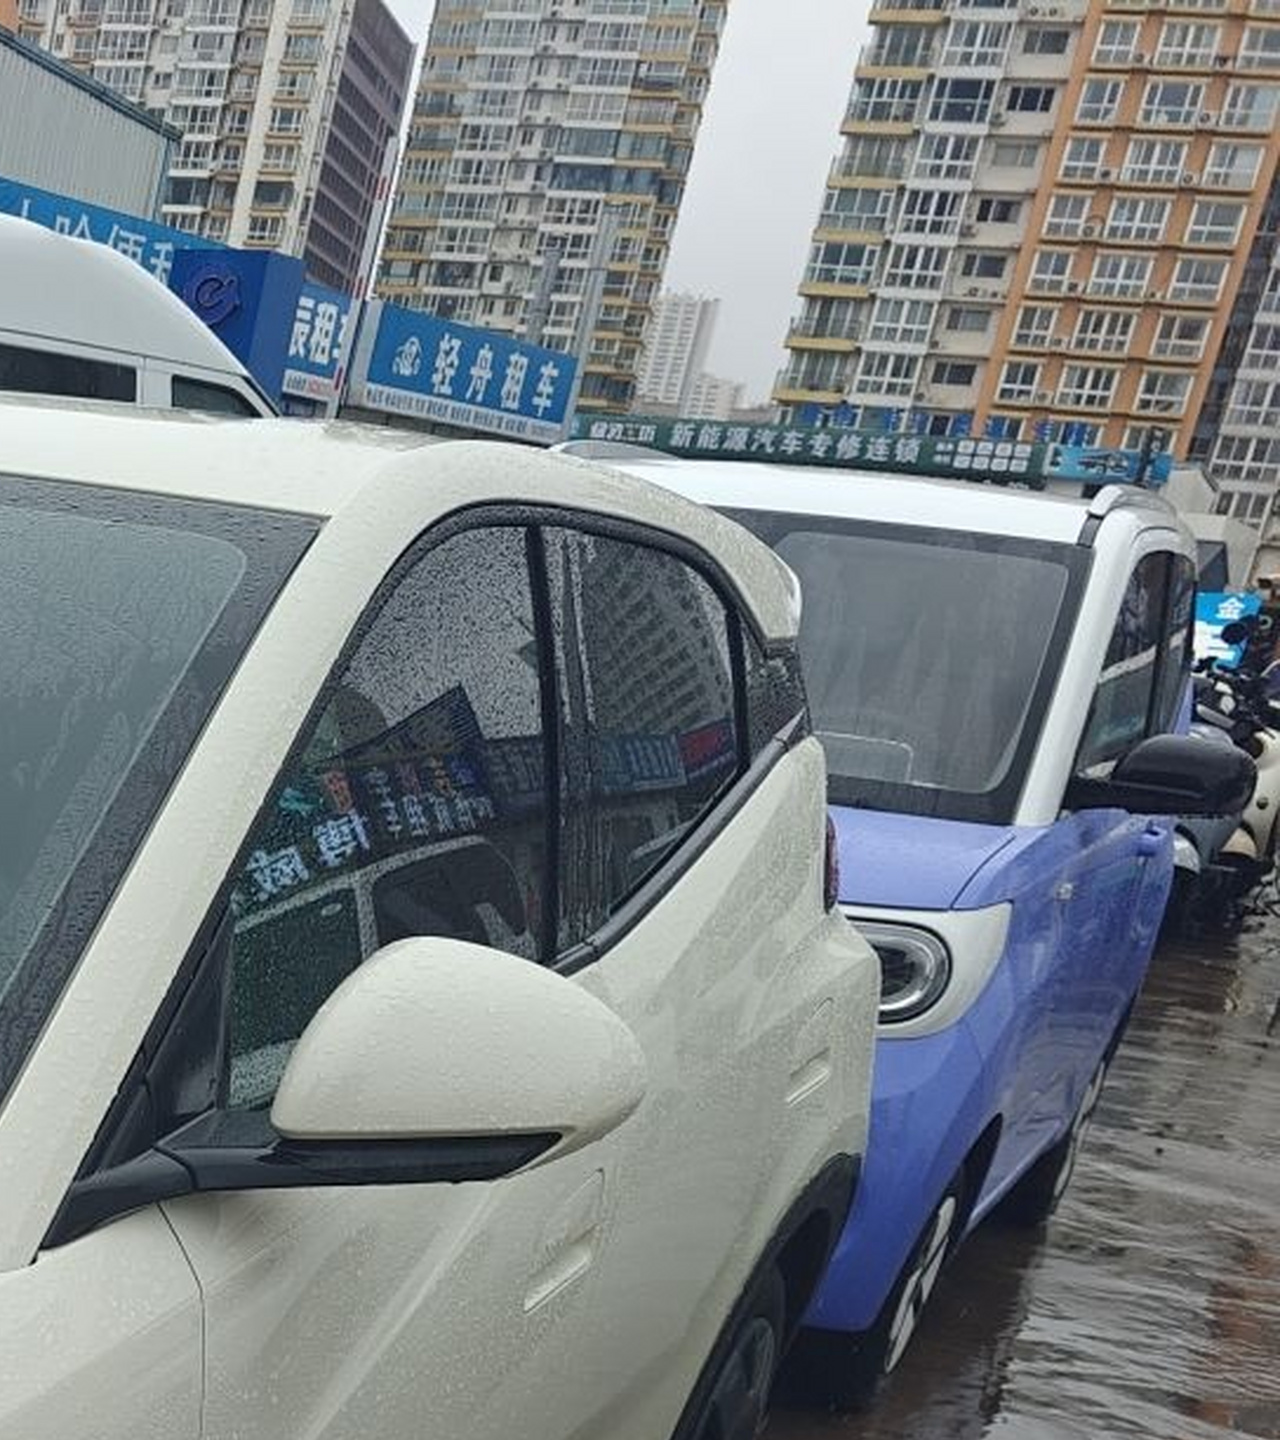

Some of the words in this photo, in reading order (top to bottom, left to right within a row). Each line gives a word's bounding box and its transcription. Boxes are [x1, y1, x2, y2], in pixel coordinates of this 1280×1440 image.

[431, 332, 560, 418] 轻舟租车
[669, 421, 923, 464] 新能源汽车专修连锁
